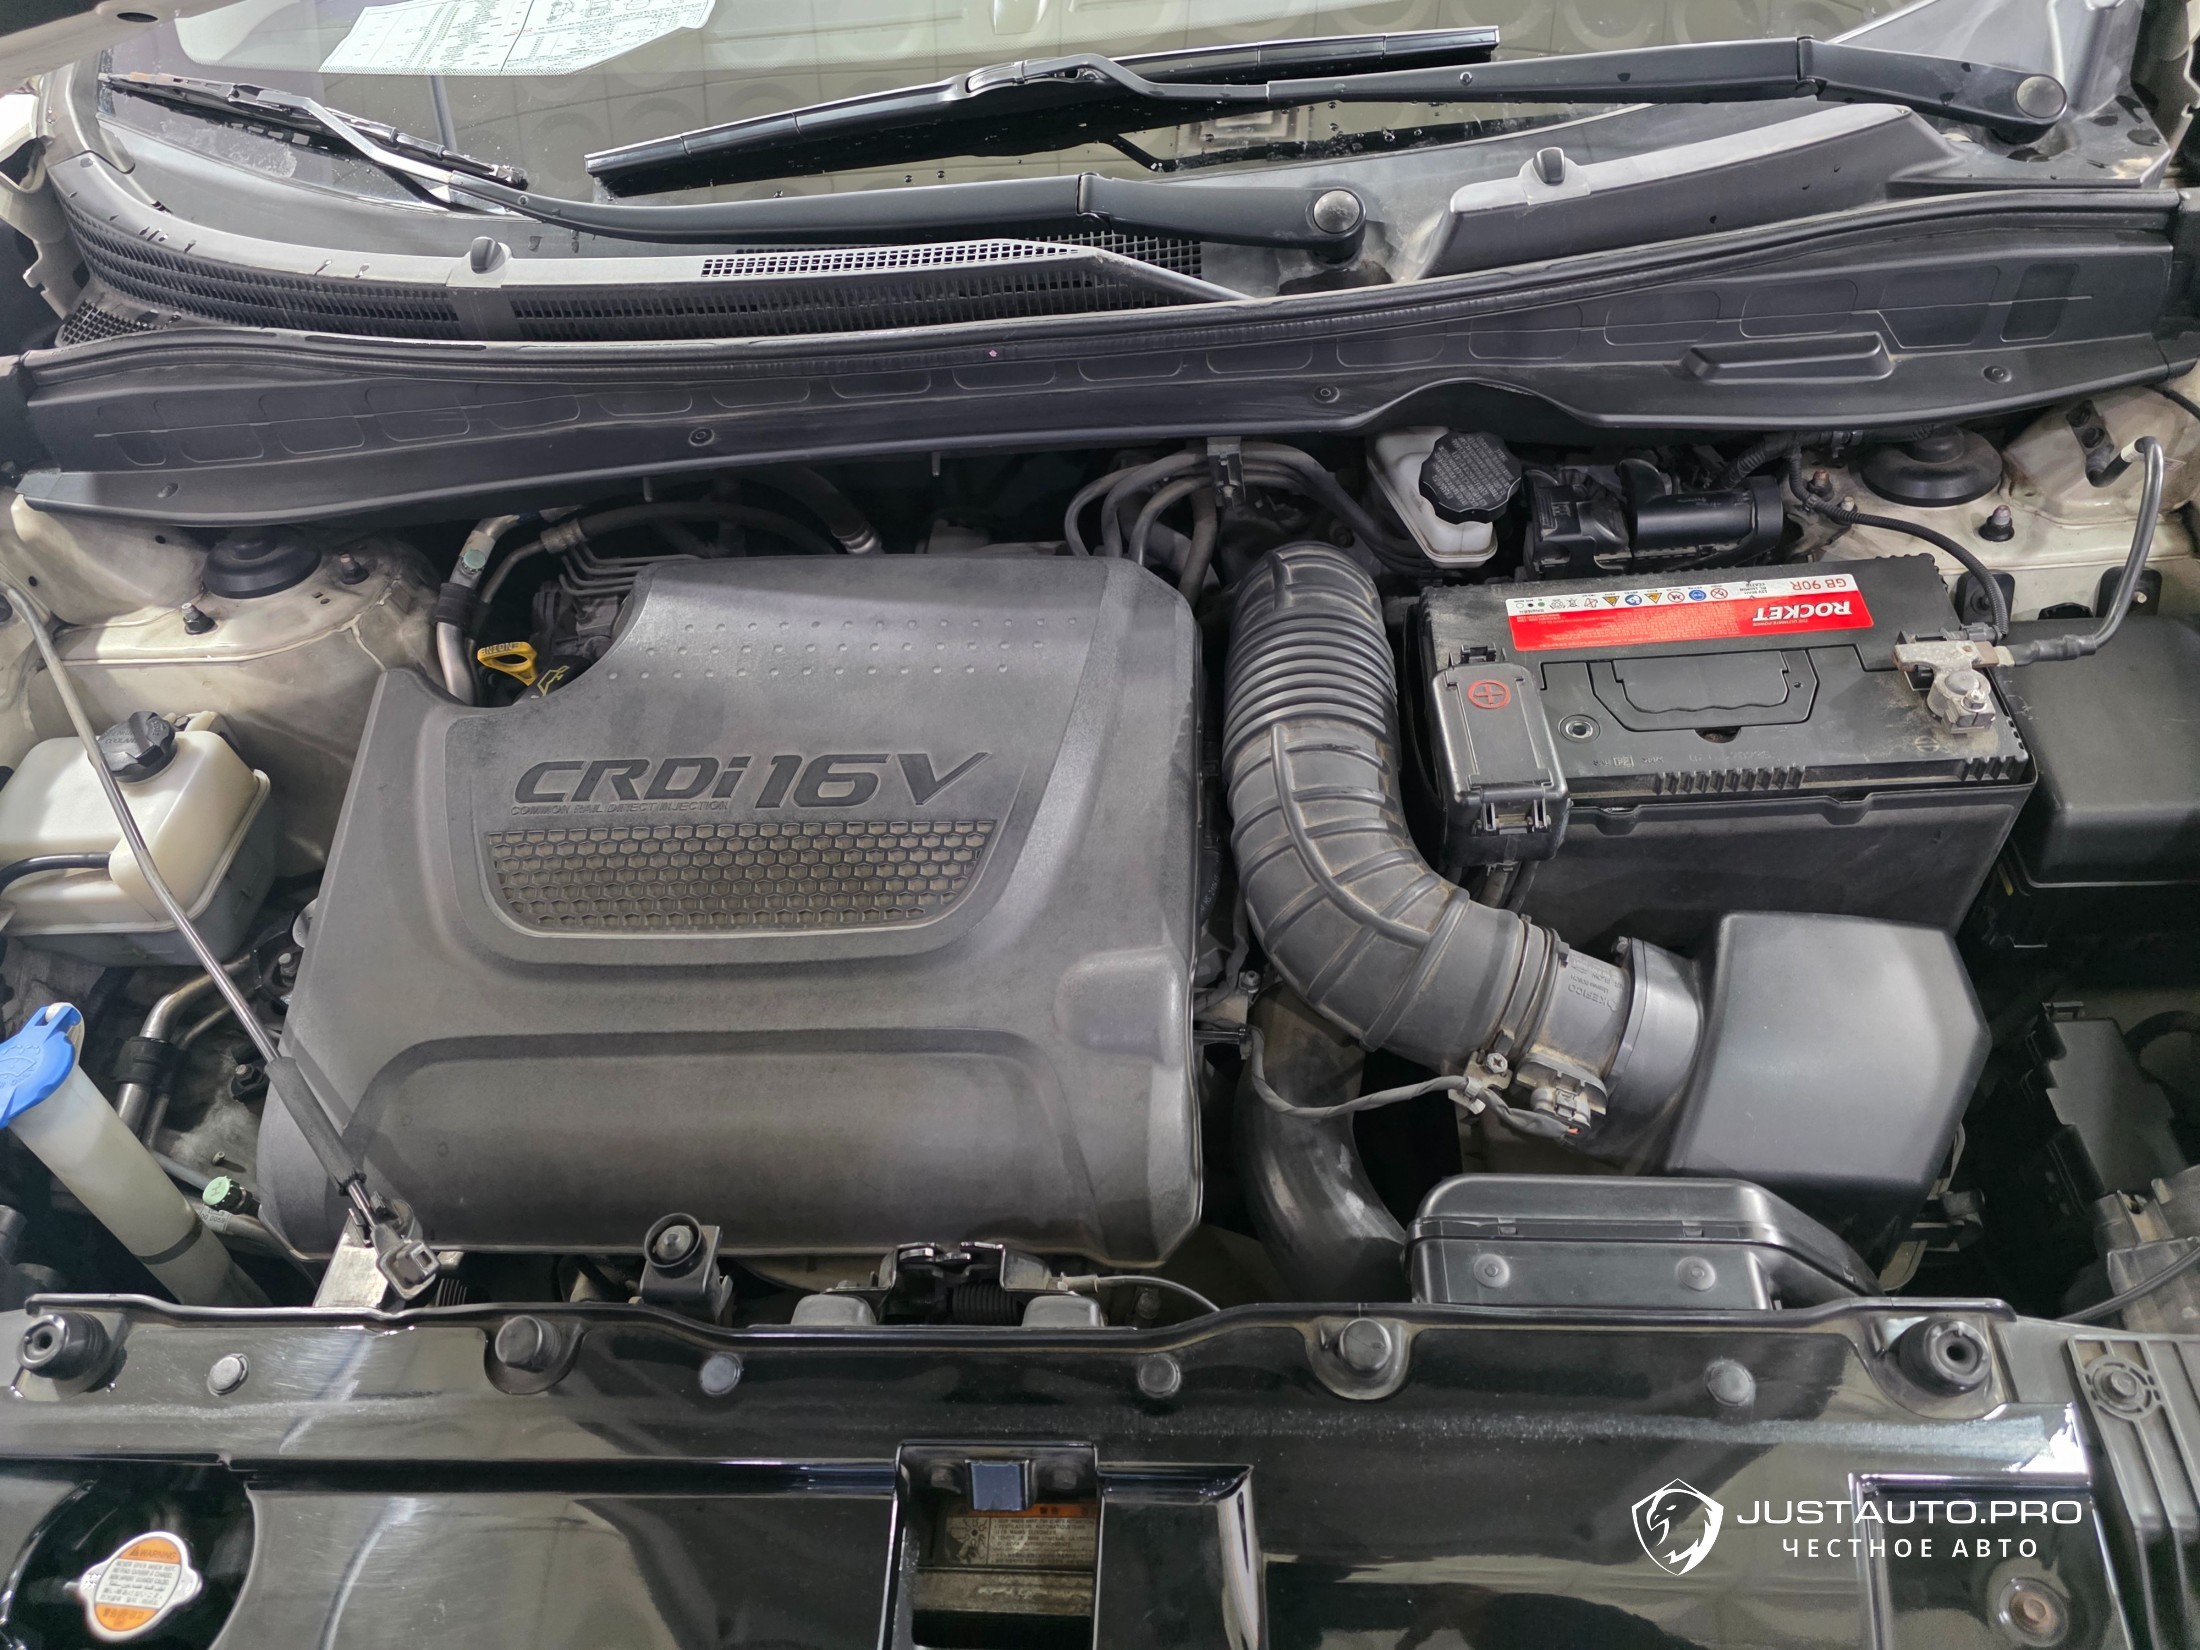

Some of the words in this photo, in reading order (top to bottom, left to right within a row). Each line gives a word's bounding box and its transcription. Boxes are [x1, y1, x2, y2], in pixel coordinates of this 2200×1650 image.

[1790, 580, 1822, 591] 90R
[1825, 578, 1847, 588] GB
[1752, 601, 1852, 621] ROCKET
[478, 642, 520, 655] ENGINE
[514, 755, 752, 803] CRDi
[753, 751, 993, 809] 16V
[511, 804, 570, 816] COMMON
[573, 803, 604, 814] RAIL
[607, 802, 657, 813] DIRECT
[658, 800, 729, 812] INJECTION
[1567, 984, 1607, 1007] KEFICO
[140, 1549, 177, 1560] WARNING
